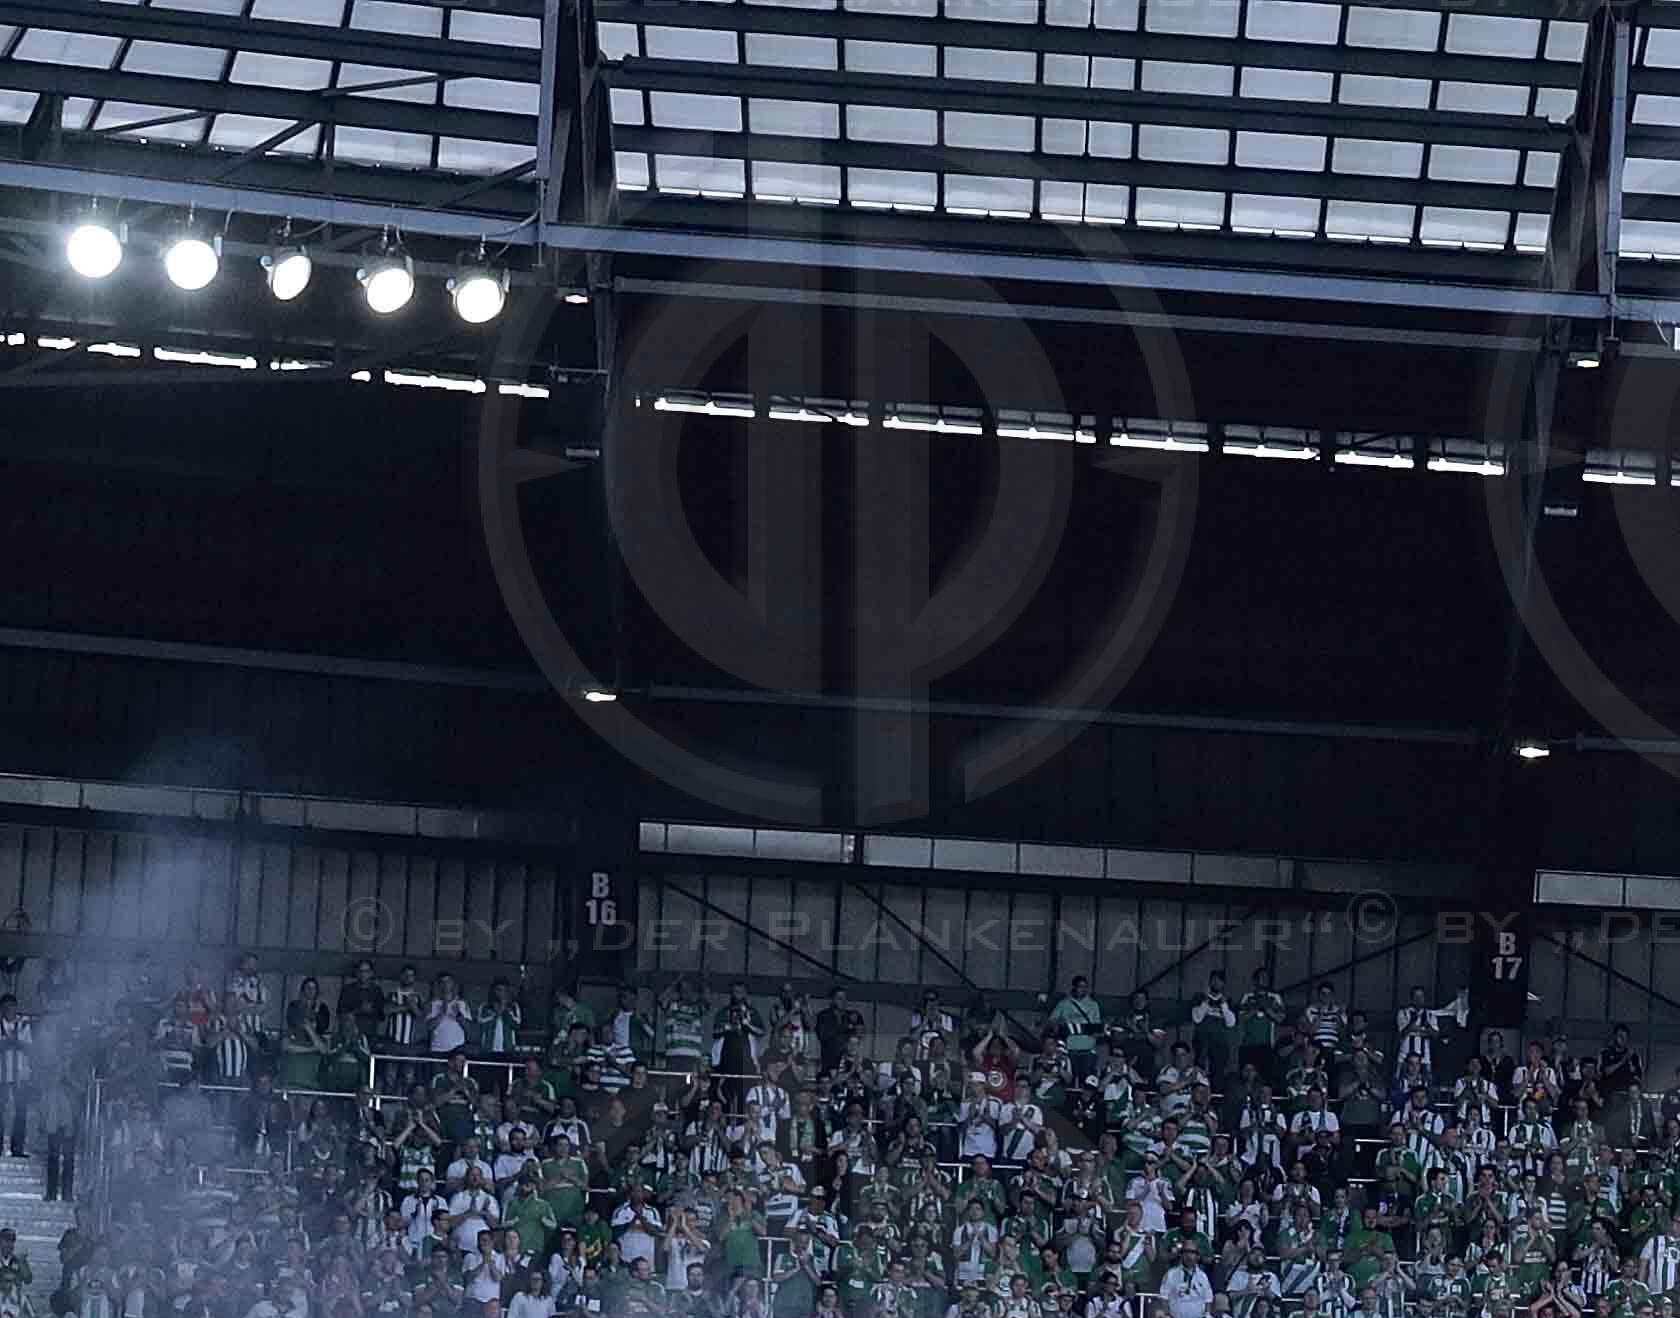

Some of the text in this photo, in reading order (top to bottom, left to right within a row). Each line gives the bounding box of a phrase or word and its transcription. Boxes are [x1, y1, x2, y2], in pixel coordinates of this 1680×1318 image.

[592, 872, 610, 898] B
[586, 900, 616, 925] 16
[1499, 933, 1516, 955] B
[1492, 957, 1522, 980] 17
